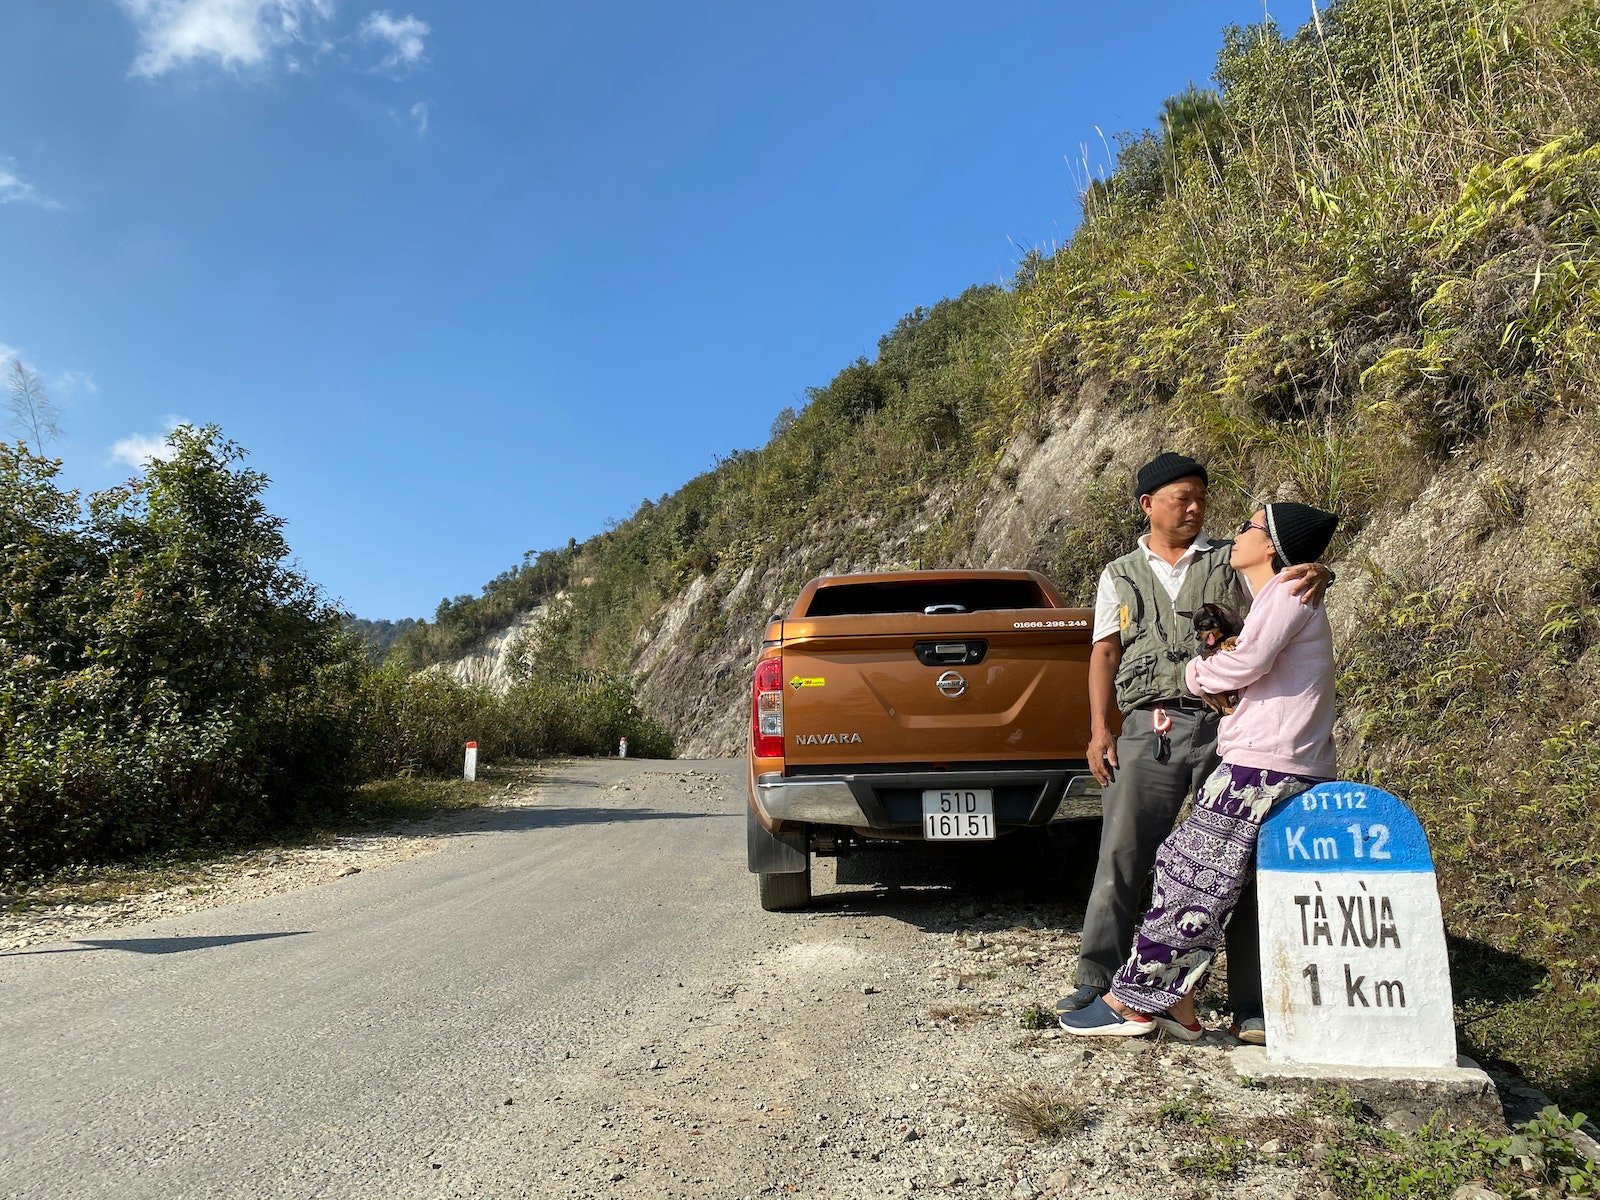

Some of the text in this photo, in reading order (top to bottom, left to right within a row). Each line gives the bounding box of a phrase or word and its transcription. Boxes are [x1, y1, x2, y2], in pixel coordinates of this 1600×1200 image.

[1013, 620, 1088, 629] 01666.298.248
[795, 732, 863, 745] NAVARA
[940, 792, 976, 813] 51D
[1302, 791, 1368, 811] ĐT112
[929, 815, 988, 836] 161.51
[1285, 823, 1392, 861] Km 12
[1294, 881, 1402, 949] TÀ XÙA
[1302, 963, 1406, 1008] 1 km
